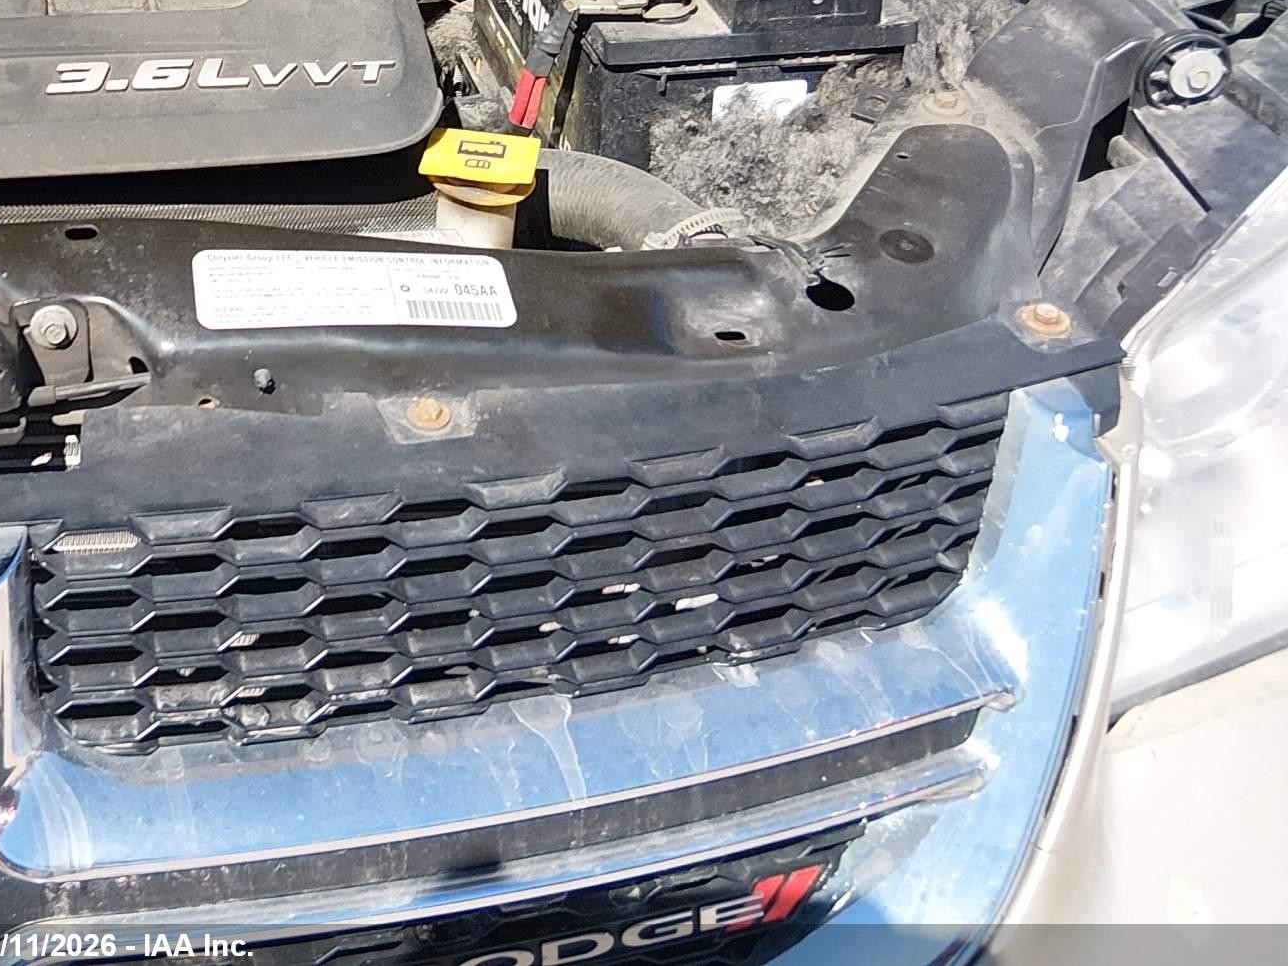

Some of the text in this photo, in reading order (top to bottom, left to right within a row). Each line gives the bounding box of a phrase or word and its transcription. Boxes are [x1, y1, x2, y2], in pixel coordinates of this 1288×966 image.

[45, 57, 397, 95] 3.6L VVT
[458, 892, 764, 966] ODGE
